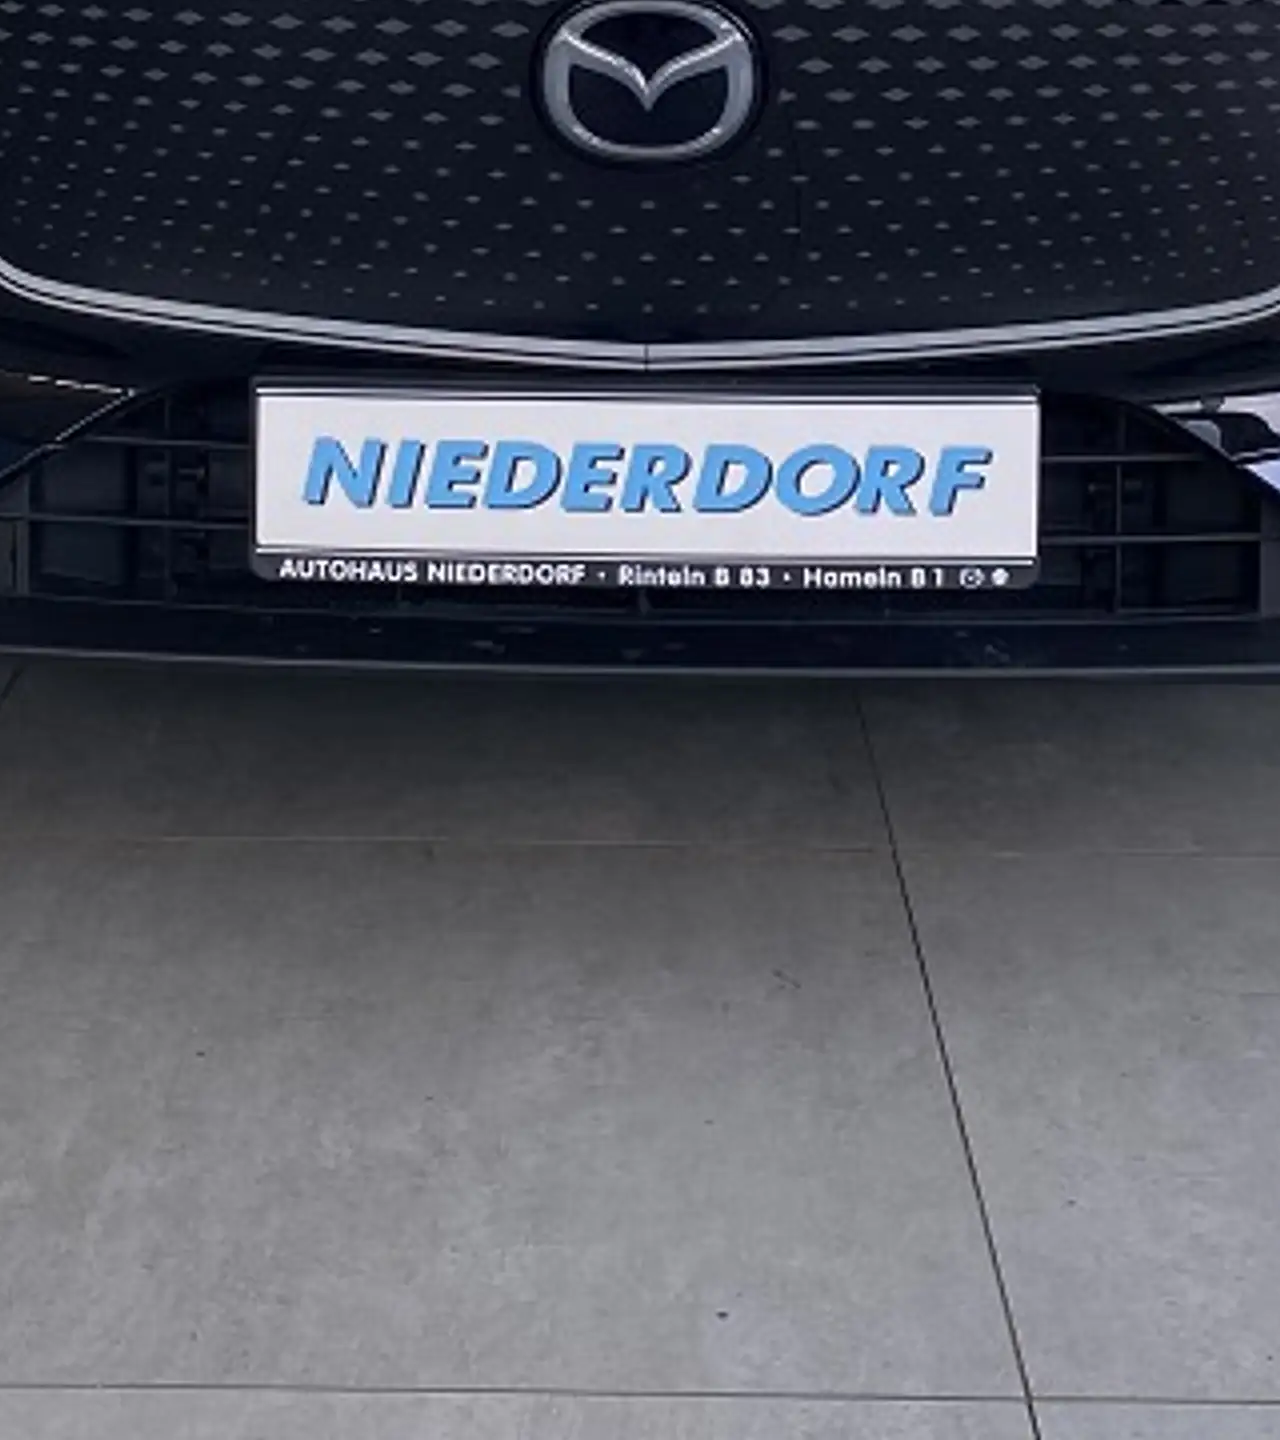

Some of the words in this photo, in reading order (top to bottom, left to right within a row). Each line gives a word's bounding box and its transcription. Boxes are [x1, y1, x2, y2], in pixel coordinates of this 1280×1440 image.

[301, 435, 993, 518] NIEDERDORF
[280, 559, 418, 582] AUTOHAUS
[427, 561, 586, 585] NIEDERDORF
